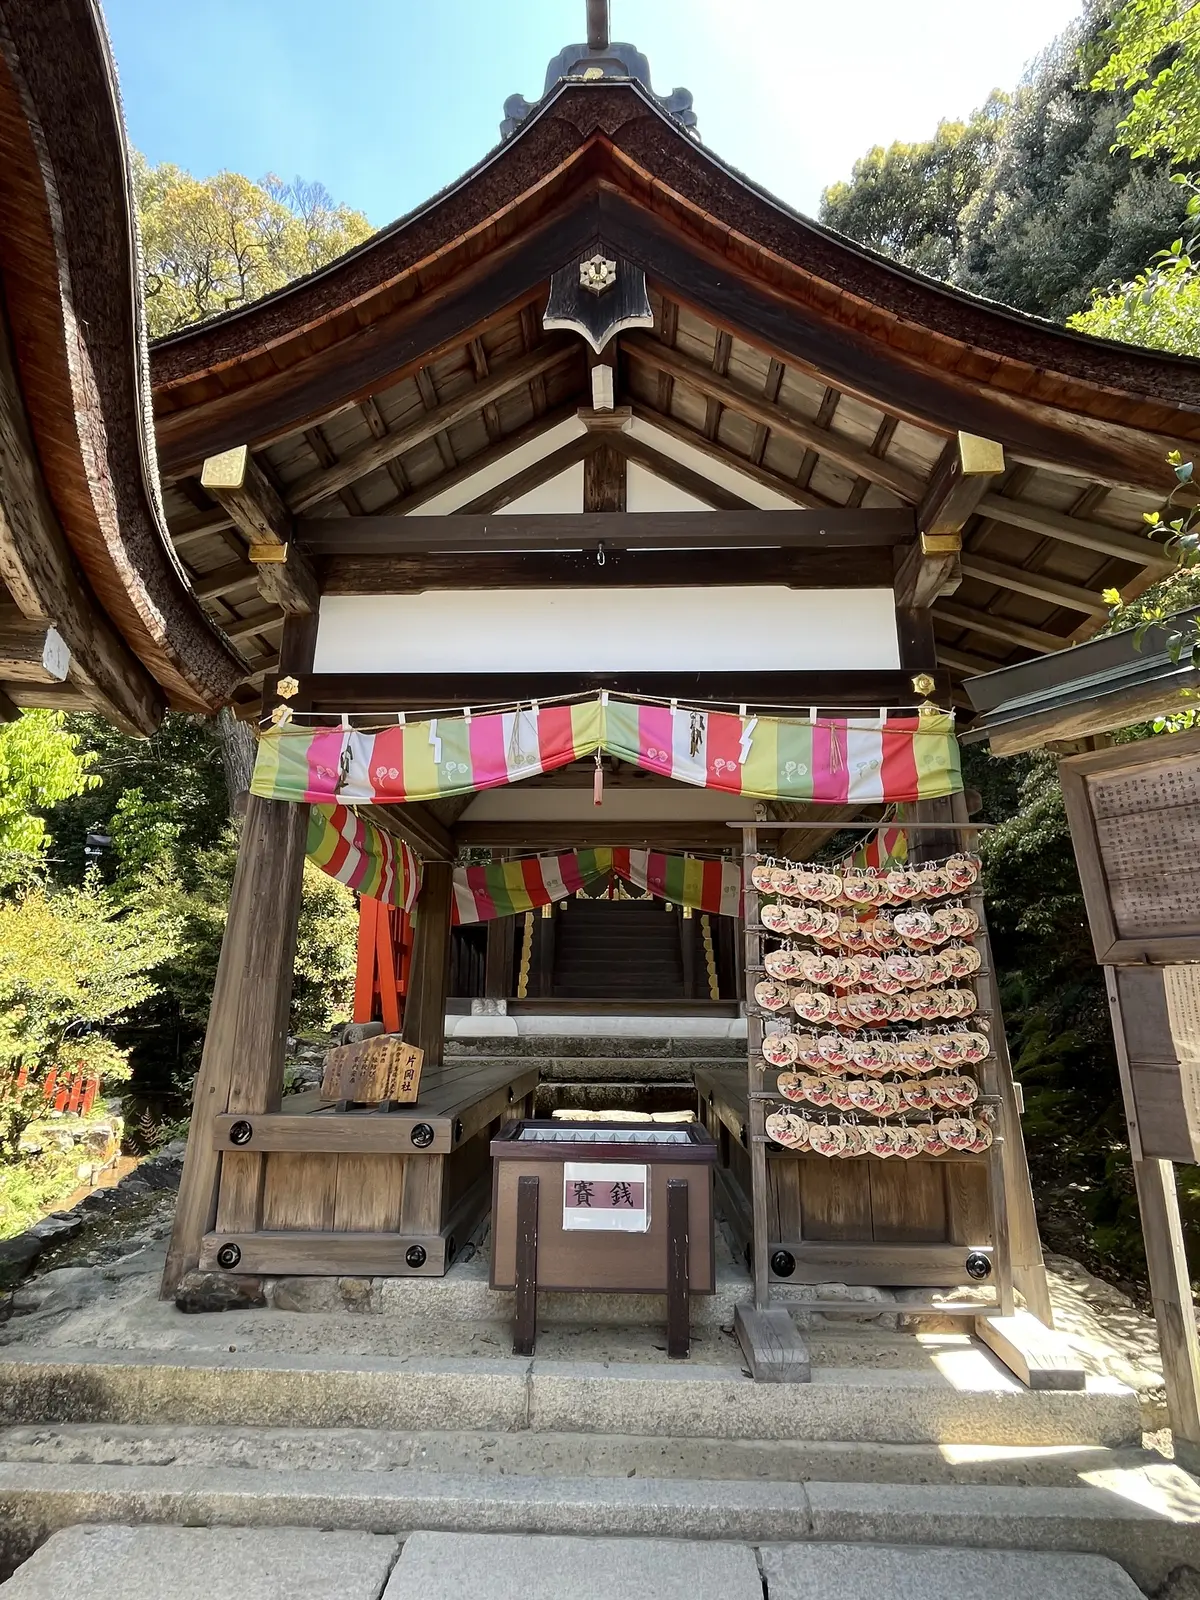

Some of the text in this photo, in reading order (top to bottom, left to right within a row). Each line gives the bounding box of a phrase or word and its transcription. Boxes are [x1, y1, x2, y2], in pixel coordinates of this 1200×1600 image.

[401, 1054, 416, 1091] 片岡社
[573, 1180, 634, 1208] 賽銭
